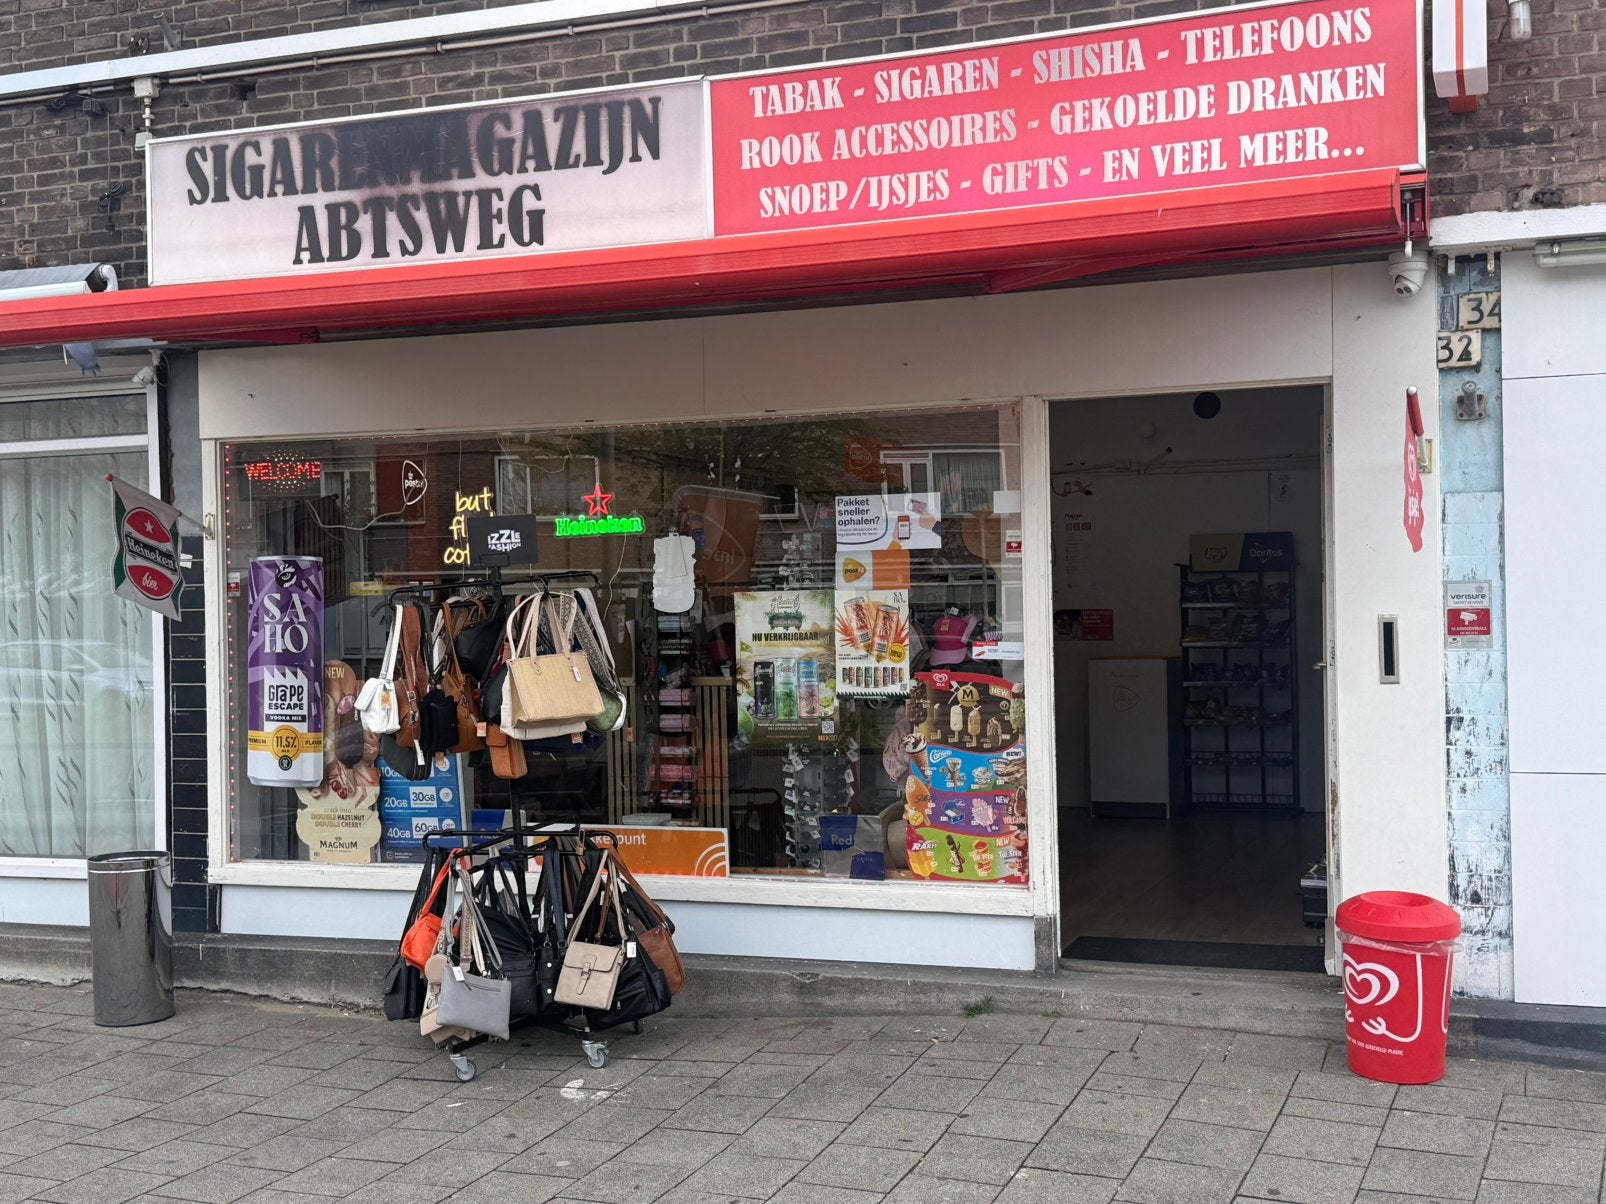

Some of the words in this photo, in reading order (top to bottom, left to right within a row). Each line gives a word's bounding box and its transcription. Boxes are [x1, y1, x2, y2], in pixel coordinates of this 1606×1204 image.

[749, 77, 844, 117] TABAK
[853, 88, 865, 97] -
[875, 57, 999, 104] SIGAREN
[1010, 68, 1022, 77] -
[1033, 38, 1145, 84] SHISHA
[1157, 49, 1169, 60] -
[1181, 7, 1372, 65] TELEFOONS
[740, 132, 822, 170] ROOK
[832, 108, 1017, 160] ACCESSOIRES
[1027, 119, 1039, 129] -
[1050, 84, 1215, 135] GEKOELDE
[1227, 63, 1386, 116] DRANKEN
[759, 168, 950, 218] SNOEP/IJSJES
[960, 179, 972, 189] -
[982, 156, 1068, 195] GIFTS
[1080, 167, 1091, 177] -
[1102, 148, 1140, 182] EN
[1151, 138, 1227, 178] VEEL
[1239, 126, 1365, 168] MEER...
[292, 183, 545, 265] ABTSWEG
[1467, 297, 1500, 325] 34
[1438, 335, 1473, 363] 32
[243, 460, 321, 480] WELCOME
[455, 487, 493, 513] but
[837, 498, 870, 507] Pakket
[838, 507, 870, 516] sneller
[555, 514, 643, 537] Heineken
[838, 516, 880, 527] ophalen?
[488, 542, 522, 552] FASHION
[126, 537, 175, 570] Heineken
[142, 572, 158, 591] bier
[263, 593, 307, 622] SA
[263, 624, 308, 654] HO
[752, 633, 763, 642] NU
[764, 631, 819, 642] VERKRIJGBAAR
[325, 667, 344, 679] NEW
[962, 689, 974, 700] M
[991, 686, 1009, 698] NEW
[268, 703, 304, 711] ESCAPE
[276, 736, 297, 748] 11.5%
[384, 797, 408, 808] 20GB
[412, 792, 435, 802] 30GB
[996, 796, 1010, 804] NEW
[337, 814, 365, 822] HAZELNUT
[387, 827, 411, 839] 40GB
[414, 822, 438, 833] 60GB
[319, 840, 358, 849] MAGNUM
[831, 834, 853, 846] Red
[996, 838, 1010, 847] NEW
